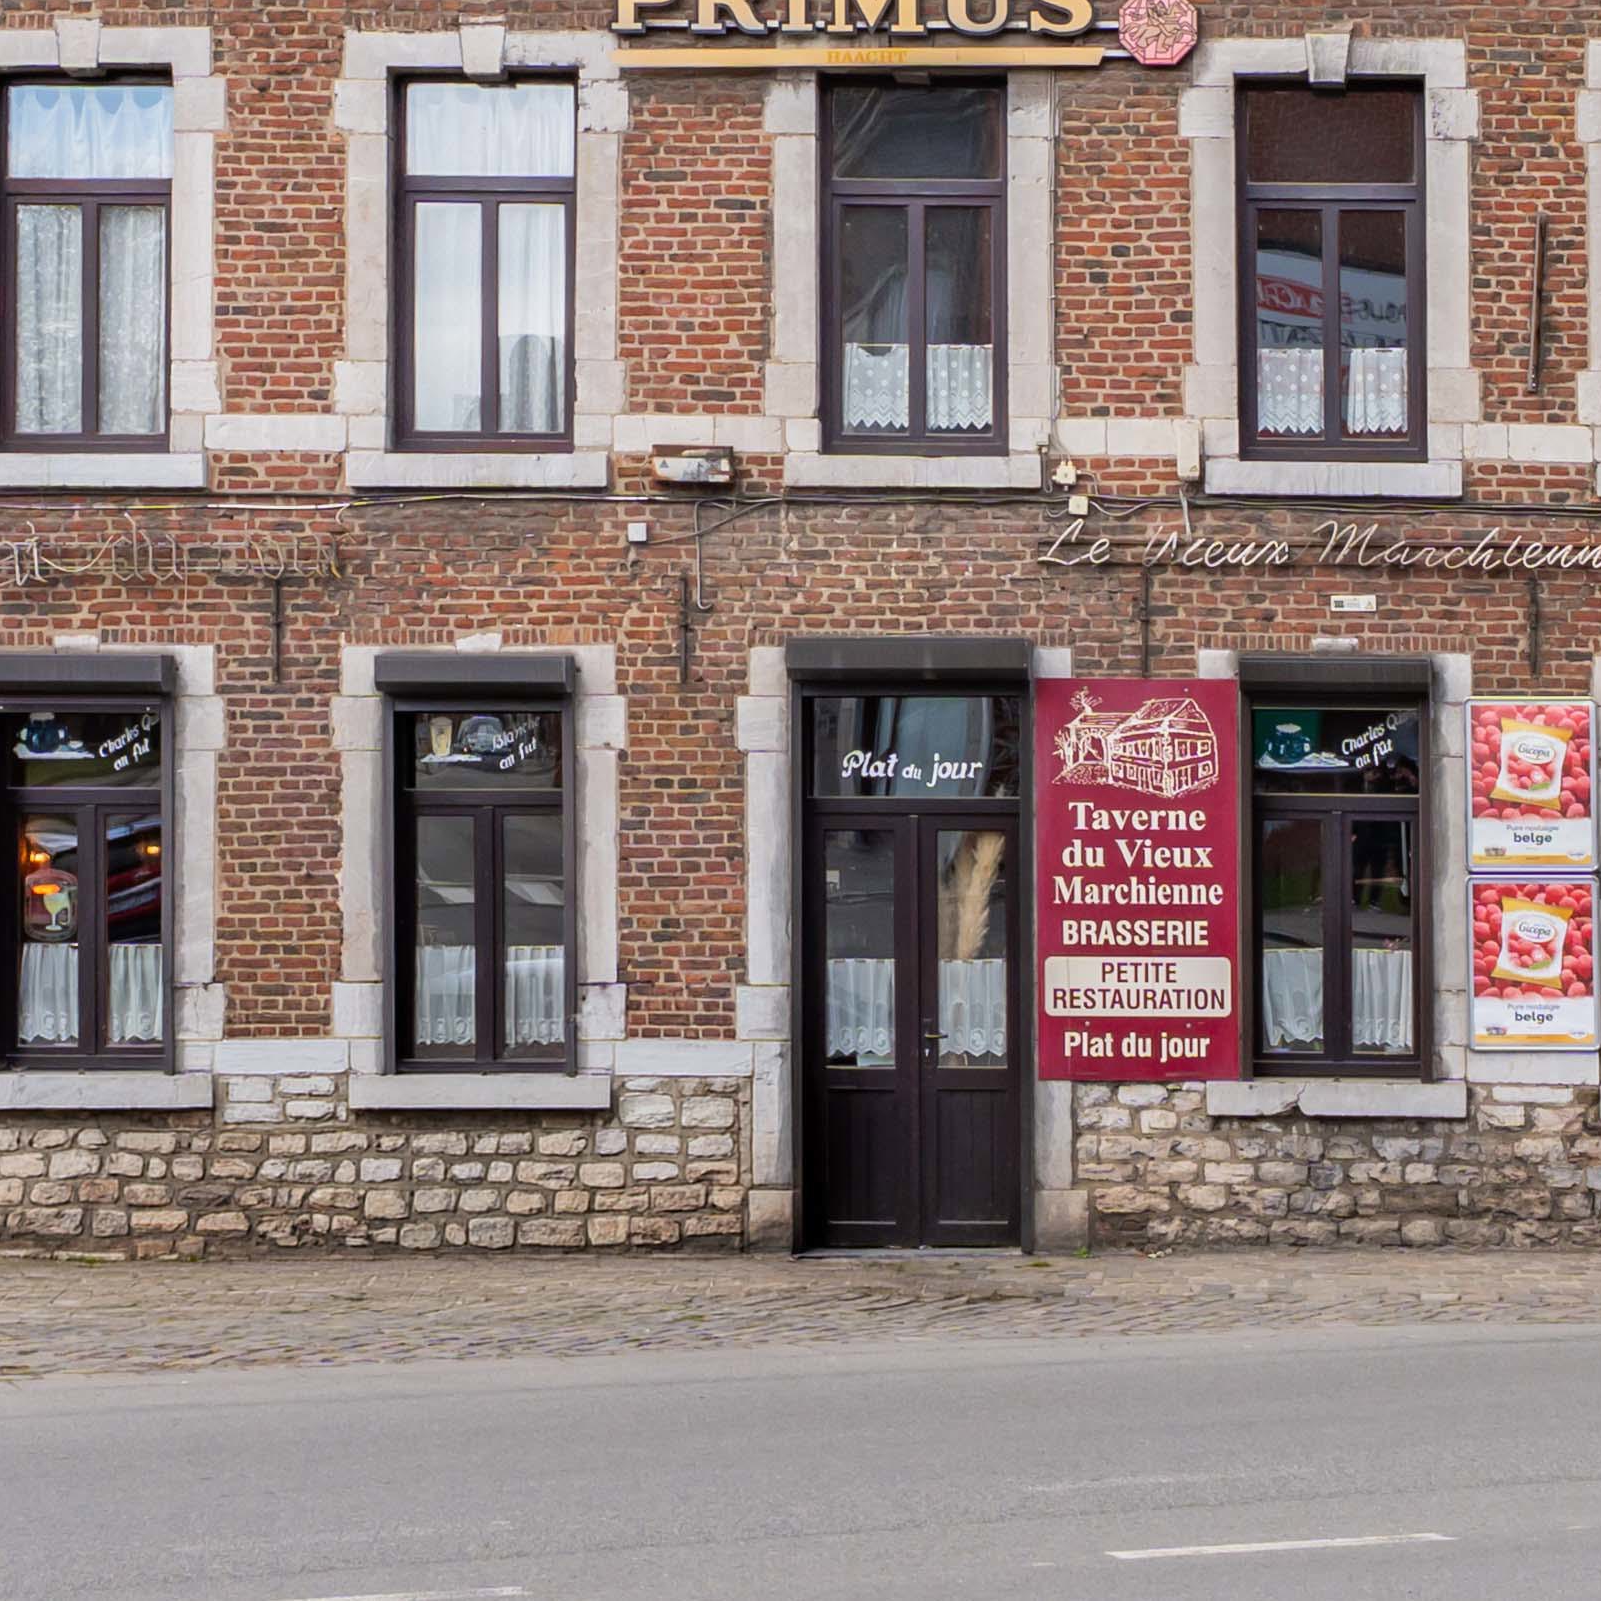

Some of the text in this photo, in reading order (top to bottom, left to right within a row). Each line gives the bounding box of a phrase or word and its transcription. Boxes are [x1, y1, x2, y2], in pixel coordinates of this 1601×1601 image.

[826, 49, 909, 65] HAACHT
[1038, 518, 1111, 566] Le
[1141, 525, 1290, 569] Vieux
[1341, 723, 1385, 755] Charles
[841, 749, 983, 788] Plat du jour
[1068, 801, 1207, 831] Taverne
[1061, 838, 1214, 868] du Vieux
[1513, 832, 1553, 846] belge
[1052, 876, 1224, 905] Marchienne
[1062, 919, 1209, 946] BRASSERIE
[1101, 962, 1178, 983] PETITE
[1053, 988, 1225, 1010] RESTAURATION
[1514, 1010, 1554, 1025] belge
[1063, 1031, 1211, 1064] Plat du jour
